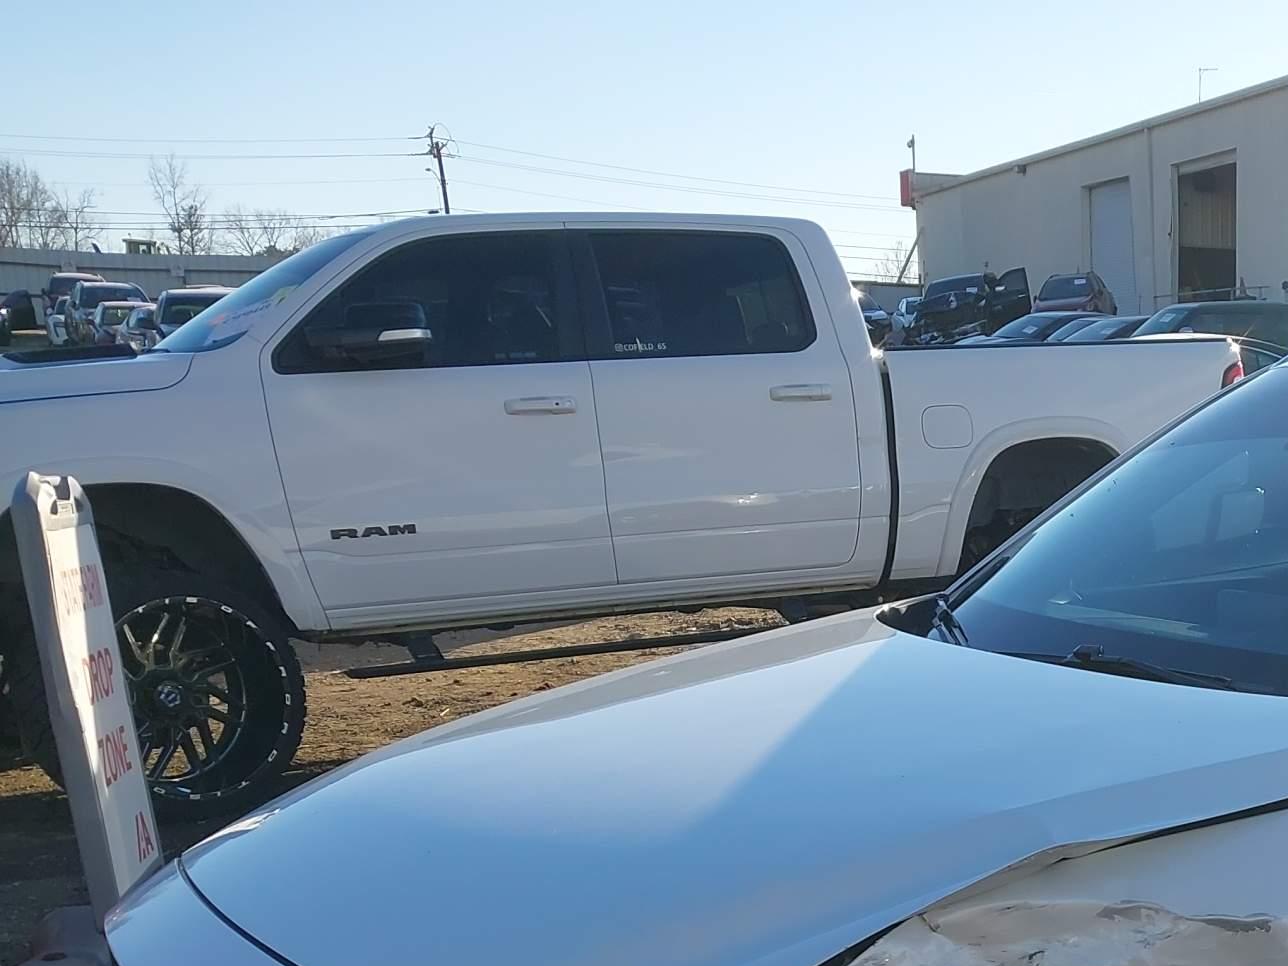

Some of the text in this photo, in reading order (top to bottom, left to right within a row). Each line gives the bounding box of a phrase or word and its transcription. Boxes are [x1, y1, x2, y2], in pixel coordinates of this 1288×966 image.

[330, 524, 417, 540] RAM
[82, 648, 114, 706] DROP
[98, 725, 132, 788] ZONE
